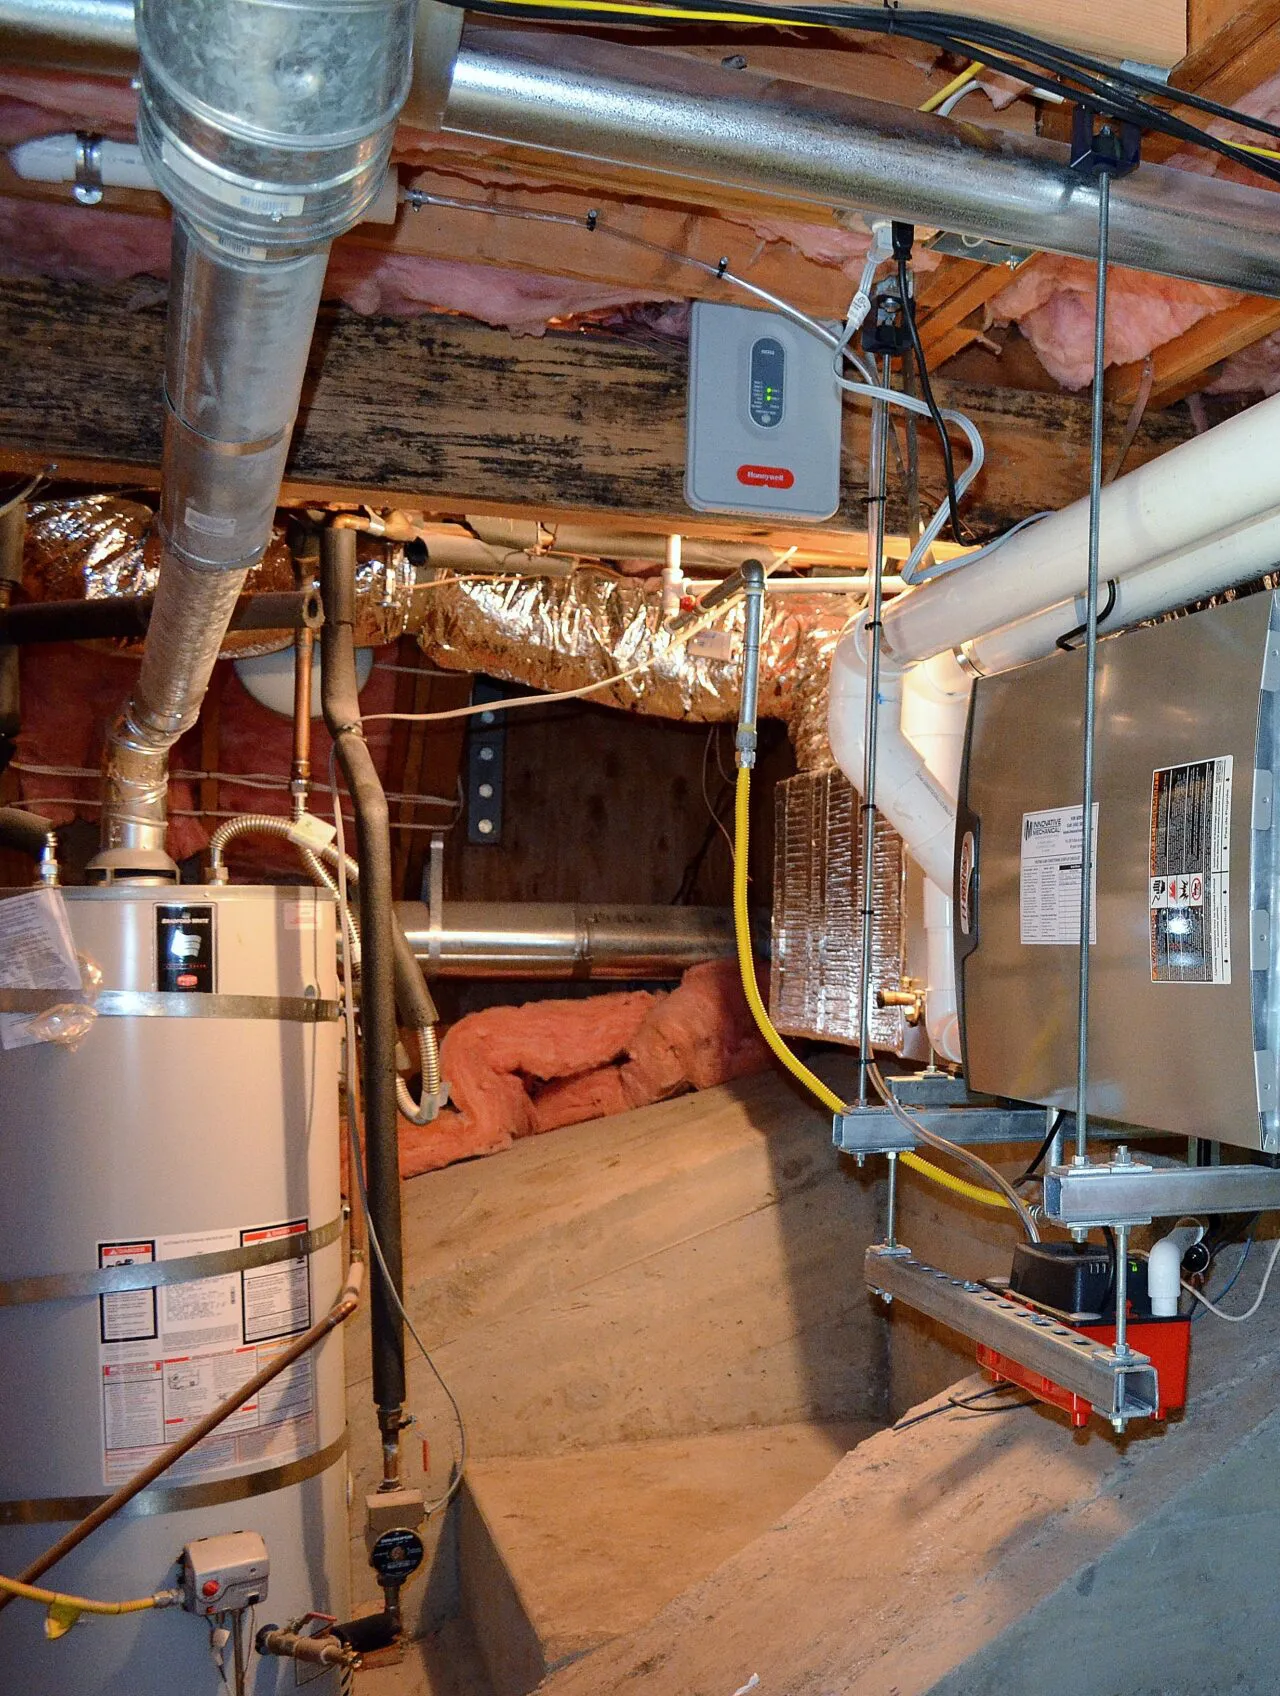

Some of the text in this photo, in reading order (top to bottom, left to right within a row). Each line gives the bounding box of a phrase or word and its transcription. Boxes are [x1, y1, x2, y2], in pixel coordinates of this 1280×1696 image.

[747, 471, 784, 482] Honeywell
[1033, 818, 1062, 828] INNOVATIVE
[1032, 827, 1061, 836] MECHANICAL
